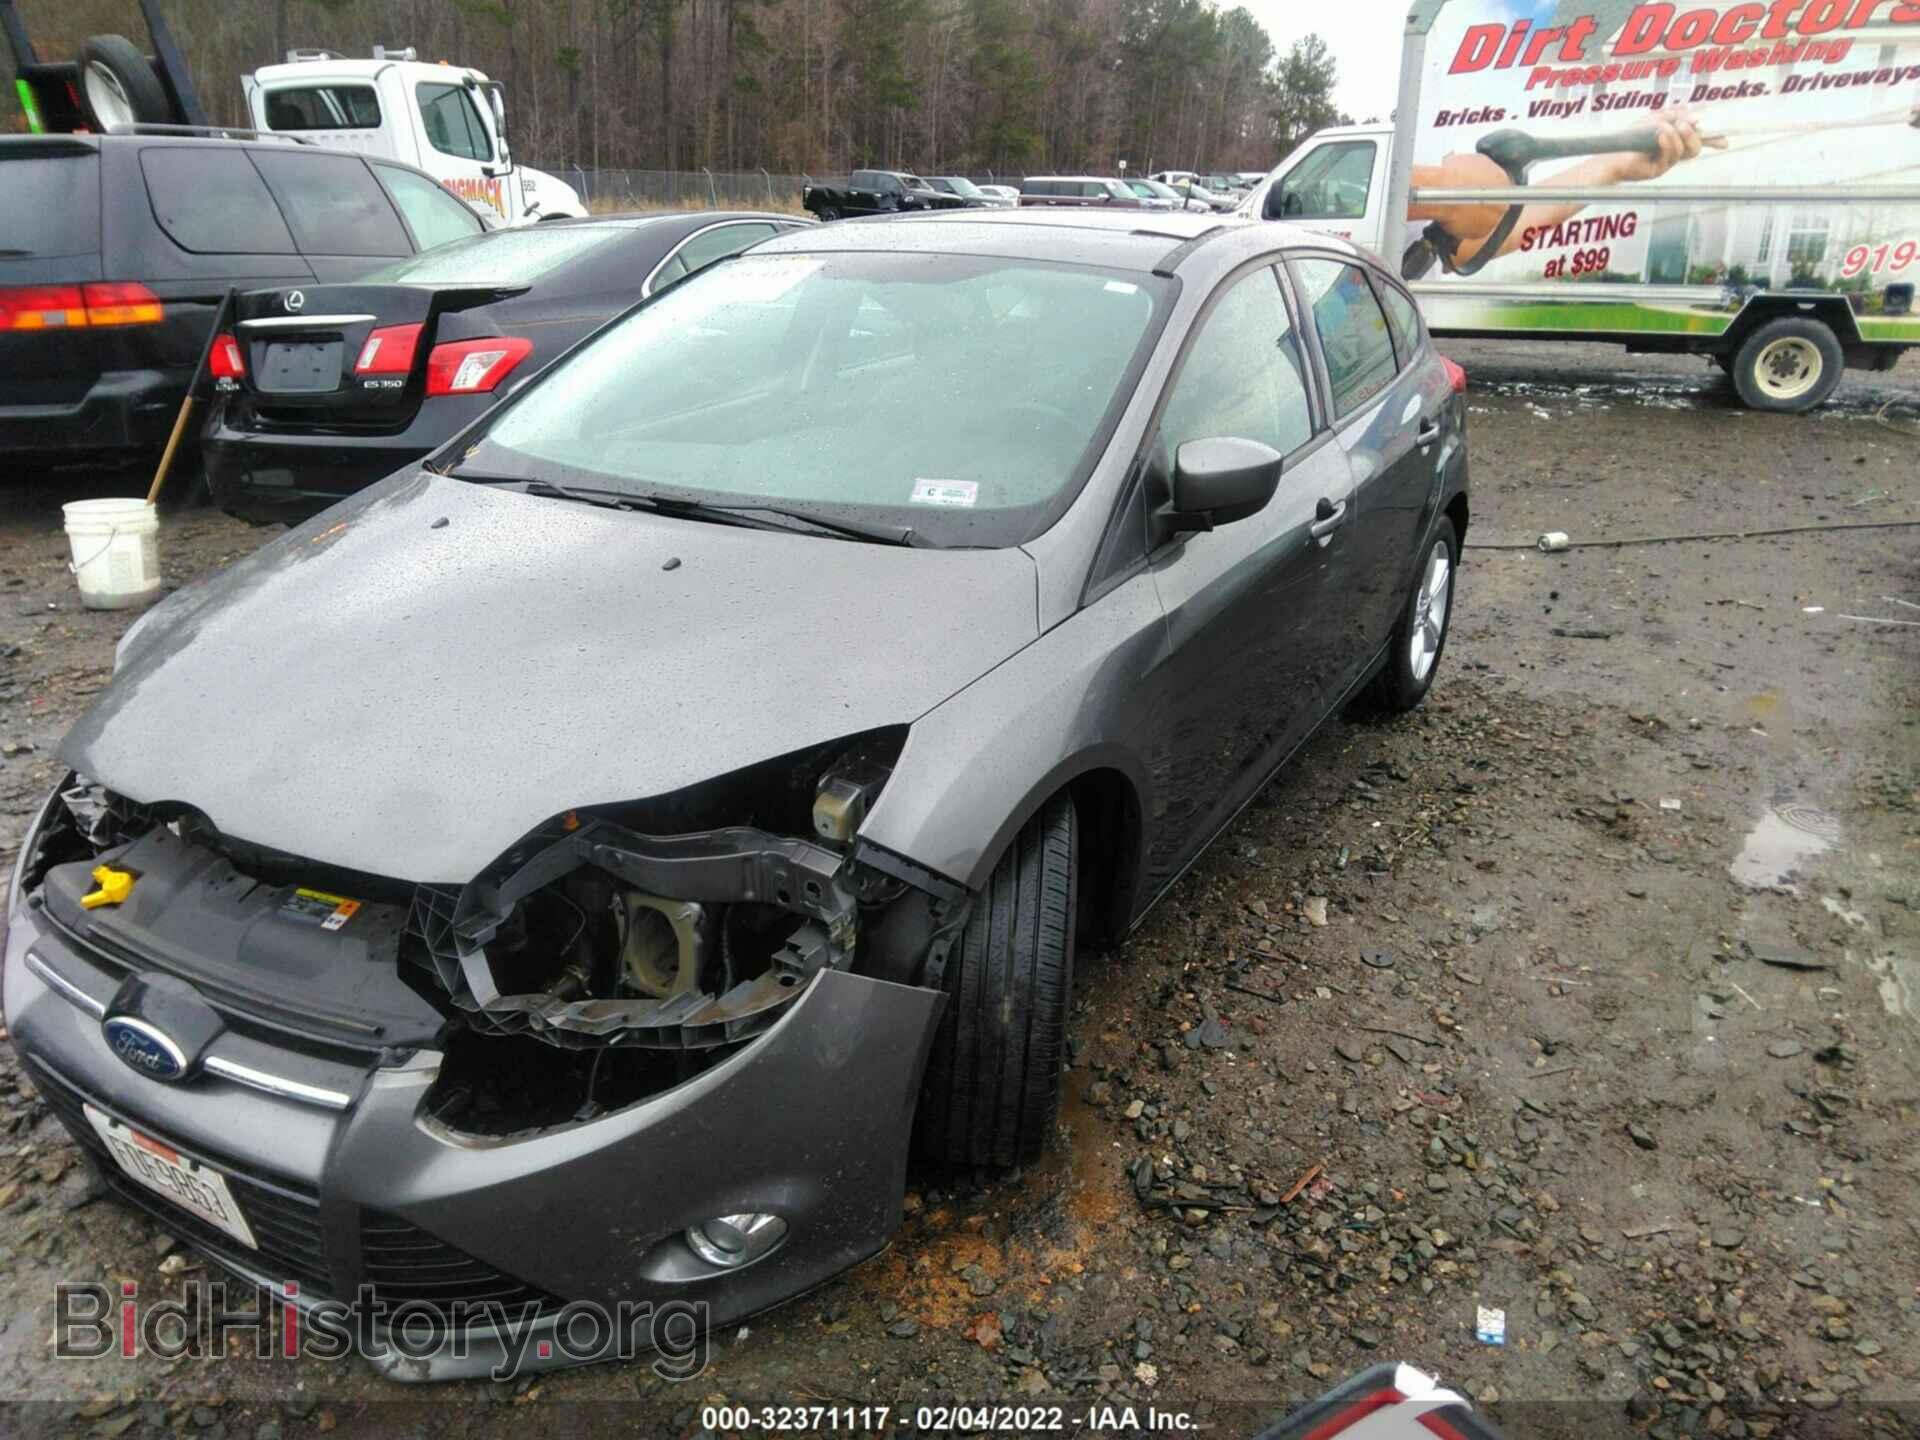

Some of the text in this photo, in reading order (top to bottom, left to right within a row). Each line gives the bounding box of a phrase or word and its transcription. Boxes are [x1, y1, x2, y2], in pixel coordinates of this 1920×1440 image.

[1447, 14, 1600, 75] Dirt
[1524, 37, 1856, 91] Pressure Washing
[1433, 105, 1506, 128] Bricks
[1527, 96, 1586, 119] Vinyl
[1591, 90, 1669, 113] Siding
[1520, 211, 1637, 252] STARTING
[1544, 247, 1610, 278] at $99
[363, 380, 403, 389] ES 350
[115, 1028, 161, 1070] Ford
